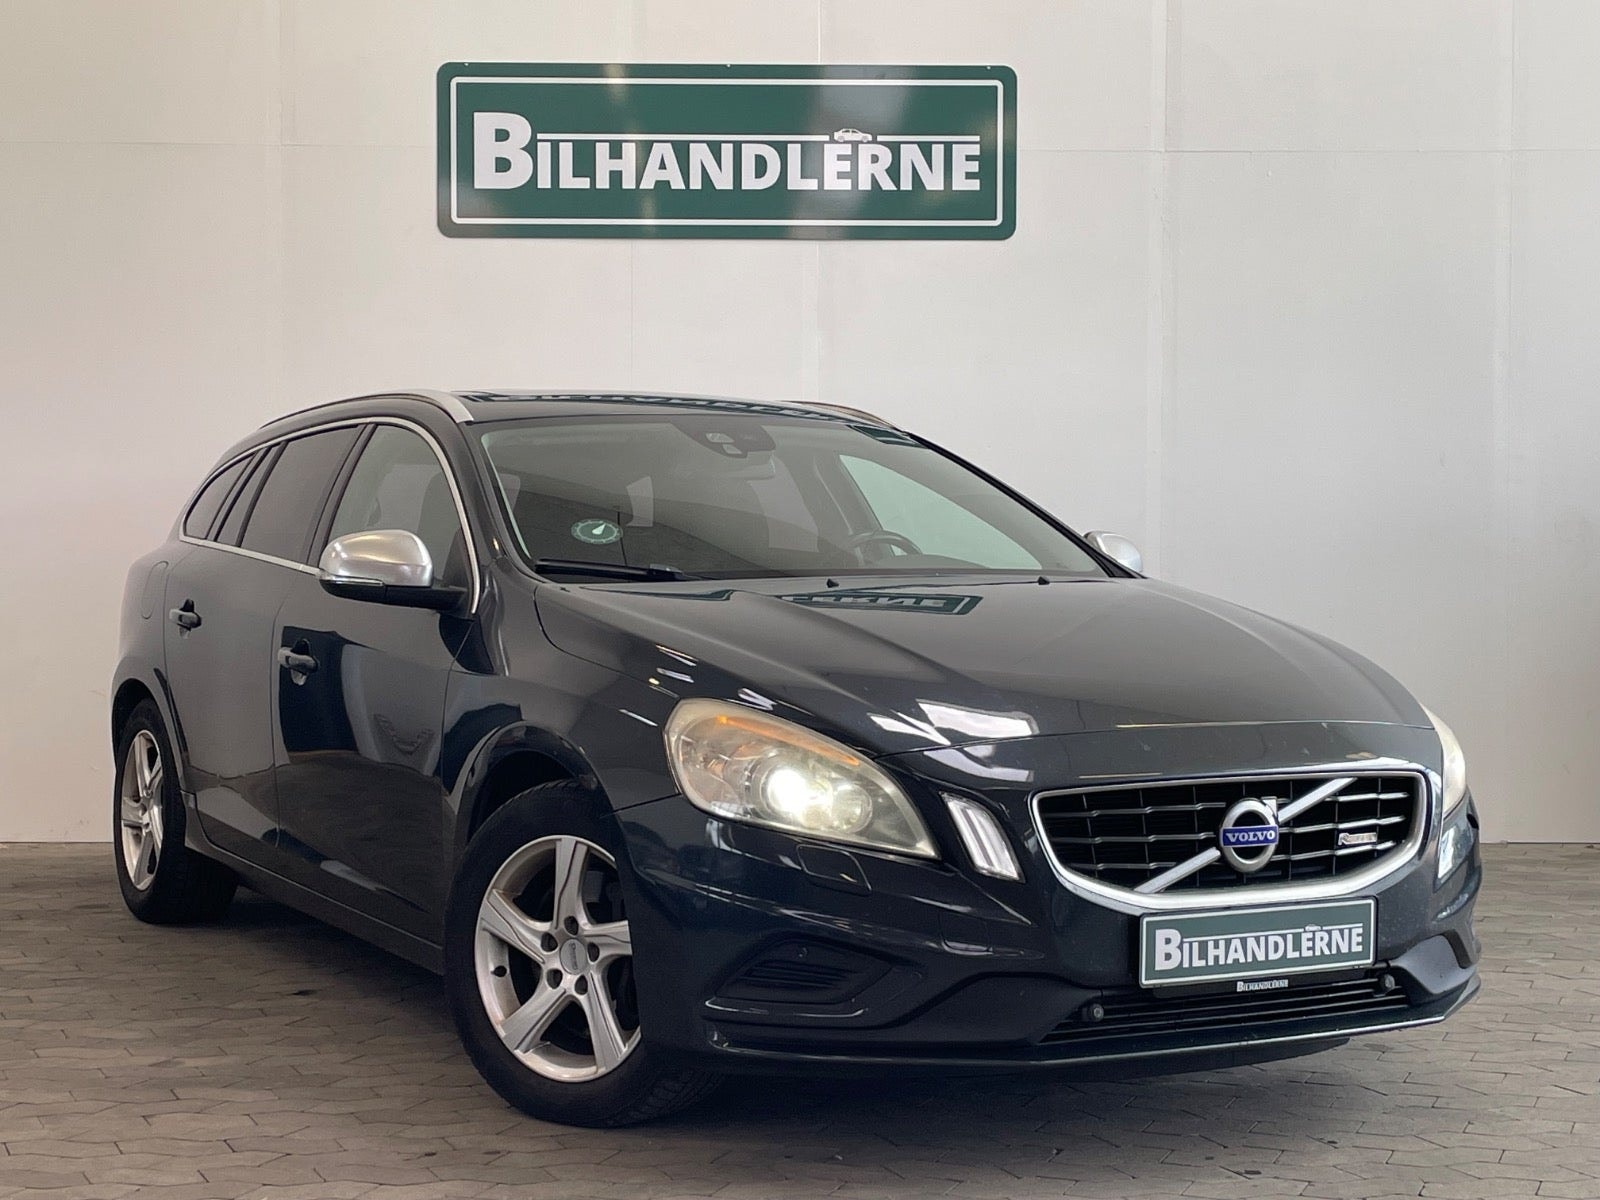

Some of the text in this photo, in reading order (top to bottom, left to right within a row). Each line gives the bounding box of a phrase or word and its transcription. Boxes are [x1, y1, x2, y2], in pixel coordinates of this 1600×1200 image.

[473, 111, 981, 191] BILHANDLERNE
[1225, 830, 1276, 842] VOLVO
[1154, 927, 1364, 971] BILHANDLERNE
